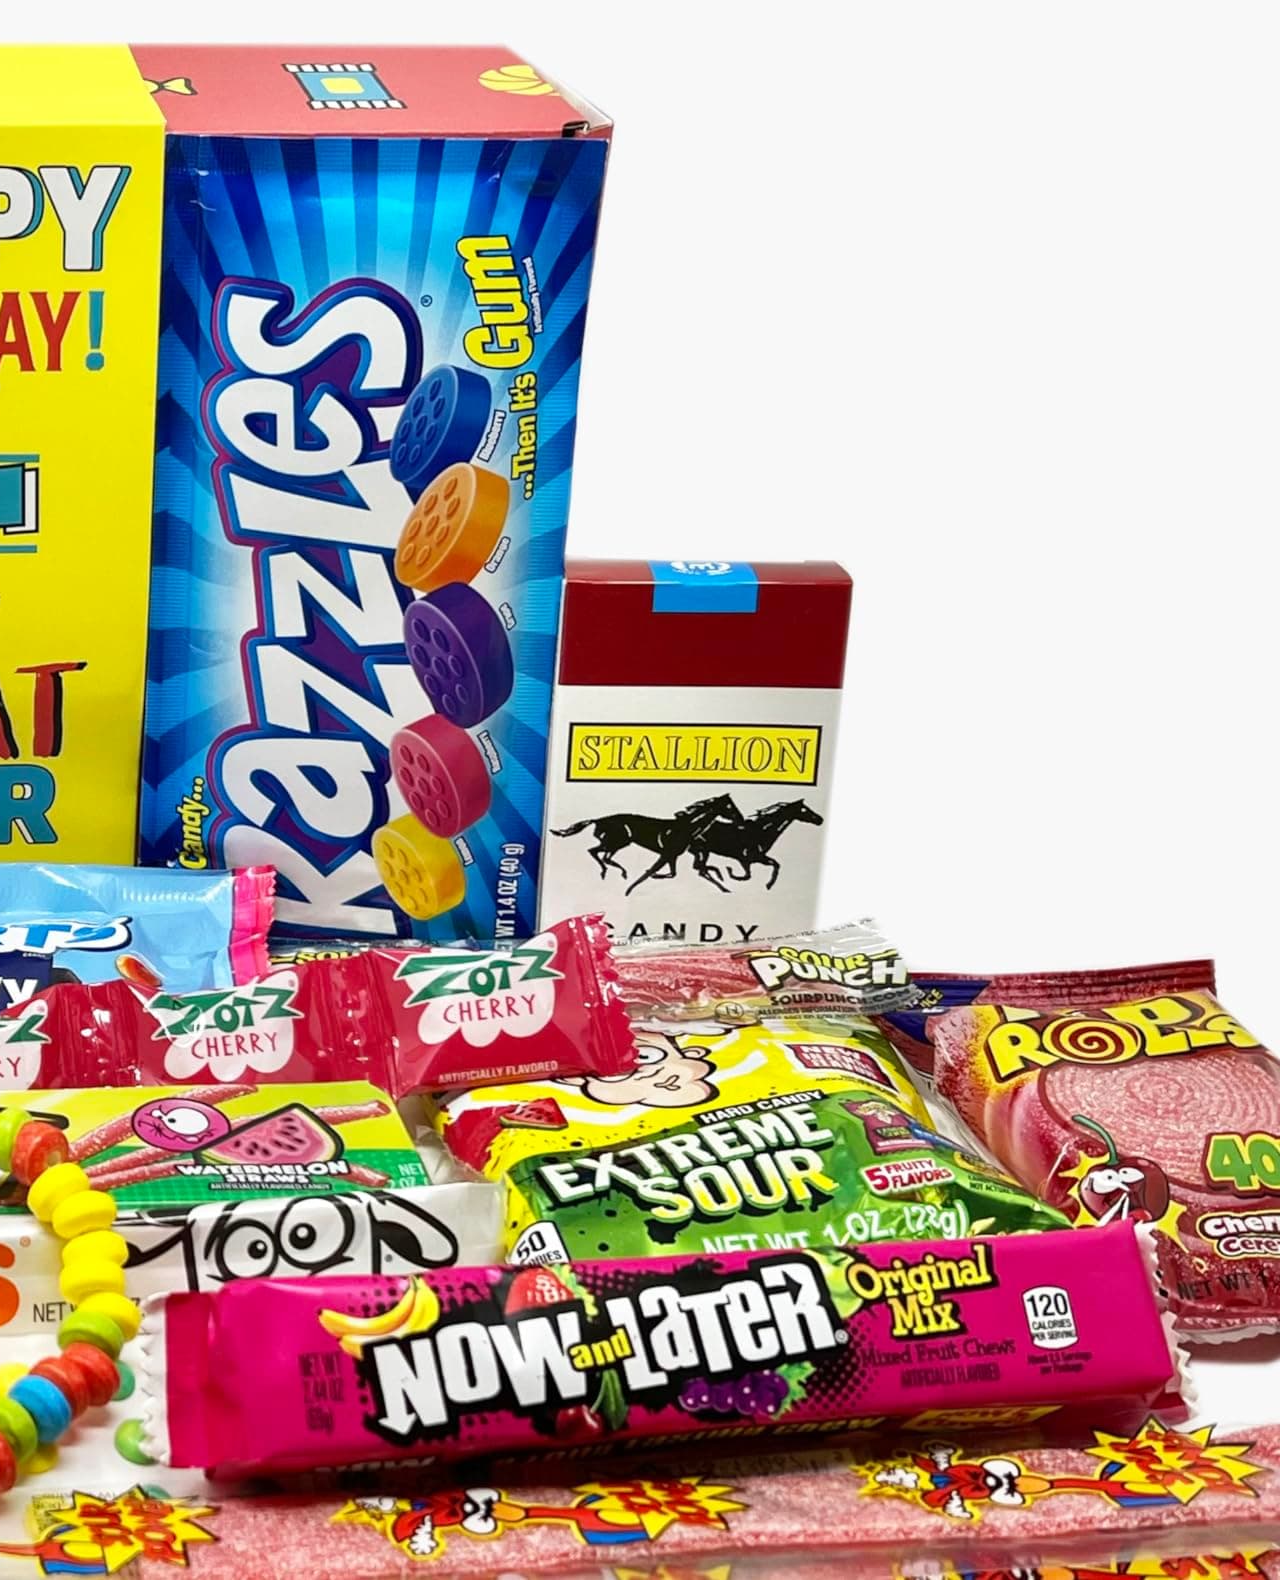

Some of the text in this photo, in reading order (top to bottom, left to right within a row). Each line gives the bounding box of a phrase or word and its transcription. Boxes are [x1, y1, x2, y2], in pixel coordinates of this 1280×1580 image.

[456, 235, 534, 369] Gum
[509, 373, 536, 412] It's
[578, 735, 811, 773] STALLION
[499, 858, 522, 876] (40
[497, 880, 518, 895] OZ
[497, 897, 516, 916] 1.4
[495, 918, 515, 938] WT
[750, 956, 908, 988] PUNCH
[443, 994, 537, 1024] CHERRY
[191, 1032, 278, 1060] CHERRY
[438, 1060, 558, 1083] ARTIFICIALLY FLAVORED
[700, 1091, 825, 1125] HARD CANDY
[540, 1103, 833, 1200] EXTREME
[177, 1160, 349, 1175] WATERMELON
[225, 1174, 310, 1183] STRAWS
[865, 1167, 890, 1191] 5
[893, 1169, 952, 1188] FLAVORS
[886, 1160, 934, 1173] FRUITY
[641, 1147, 840, 1222] SOUR
[904, 1202, 969, 1240] (28g)
[701, 1234, 763, 1256] NET
[847, 1244, 993, 1304] Original
[33, 1303, 63, 1323] NET
[889, 1296, 960, 1336] Mix
[1027, 1292, 1069, 1317] 120
[1031, 1318, 1072, 1331] CALORIES
[1032, 1330, 1048, 1341] PER
[861, 1337, 1016, 1367] Mixed Fruit Chews
[375, 1311, 631, 1437] NOW and
